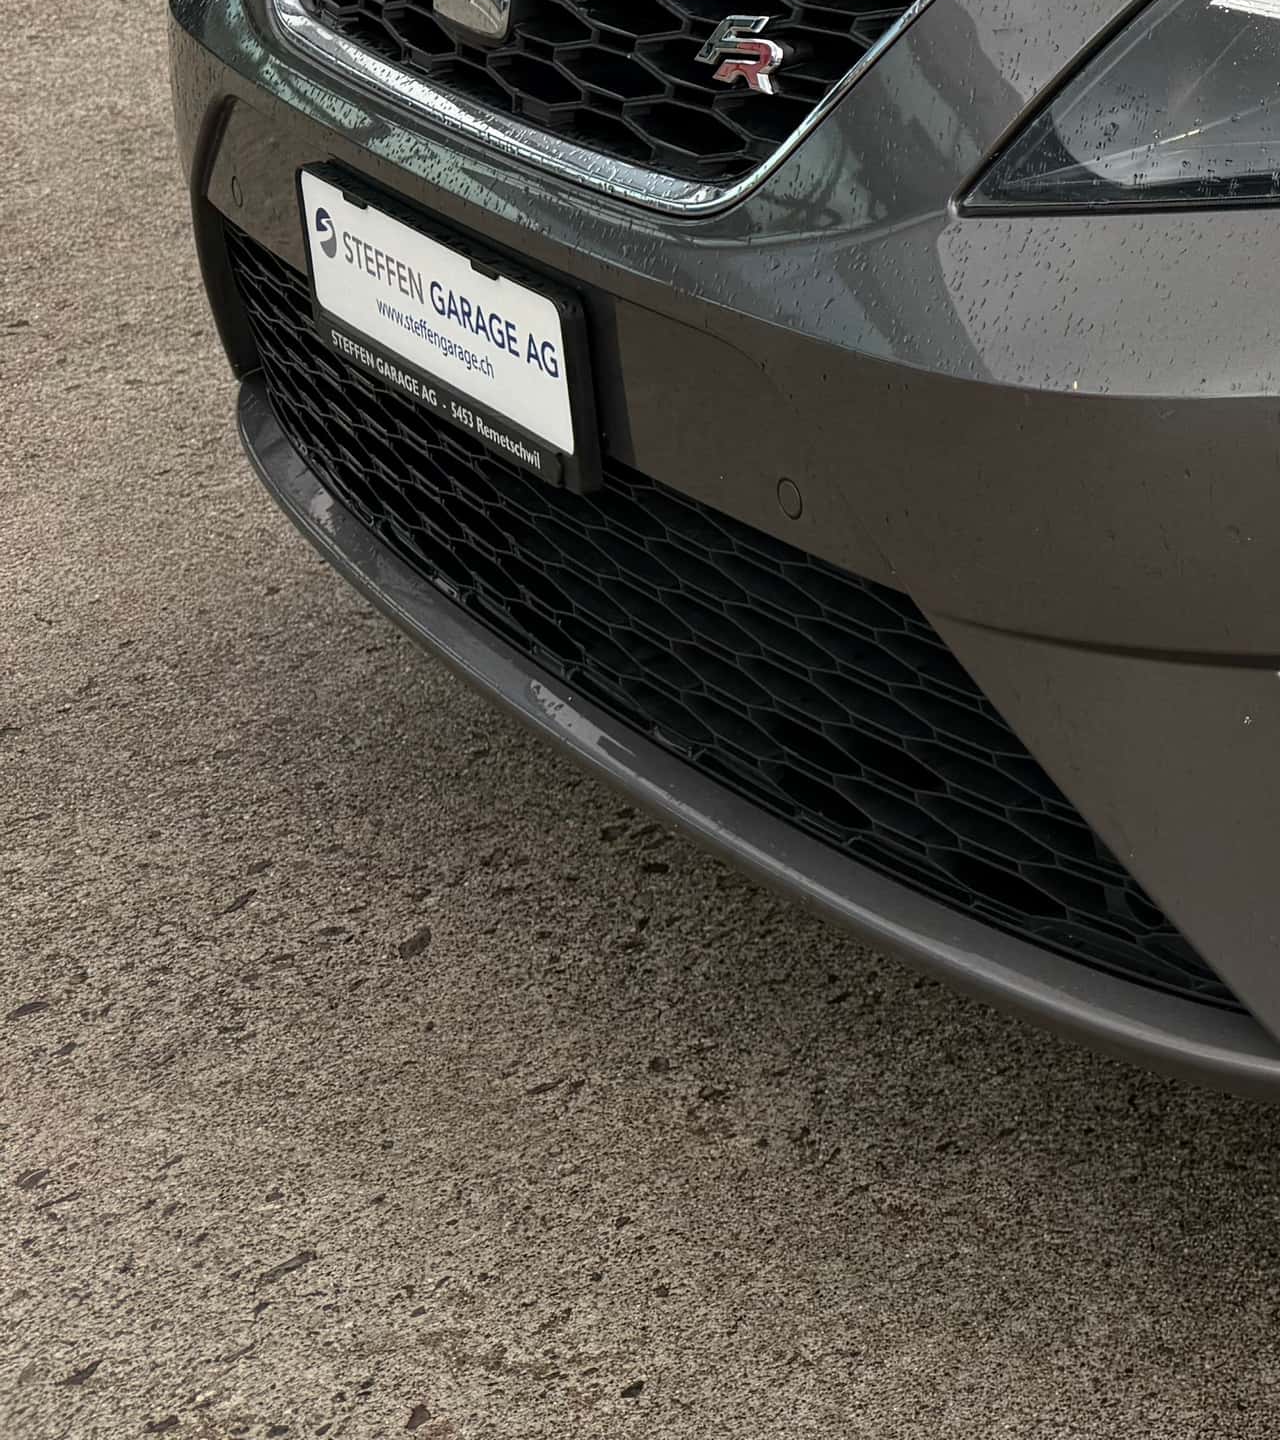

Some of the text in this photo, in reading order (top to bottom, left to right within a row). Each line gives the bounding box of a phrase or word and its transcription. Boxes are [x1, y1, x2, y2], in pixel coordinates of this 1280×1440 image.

[694, 14, 784, 95] FR
[342, 231, 560, 378] STEFFEN GARAGE AG
[376, 298, 495, 379] www.steffengarage.ch
[330, 329, 375, 369] STEFFEN
[376, 357, 420, 396] GARAGE
[421, 384, 438, 407] AG
[450, 401, 474, 429] 5453
[475, 415, 542, 470] Remetschwil
